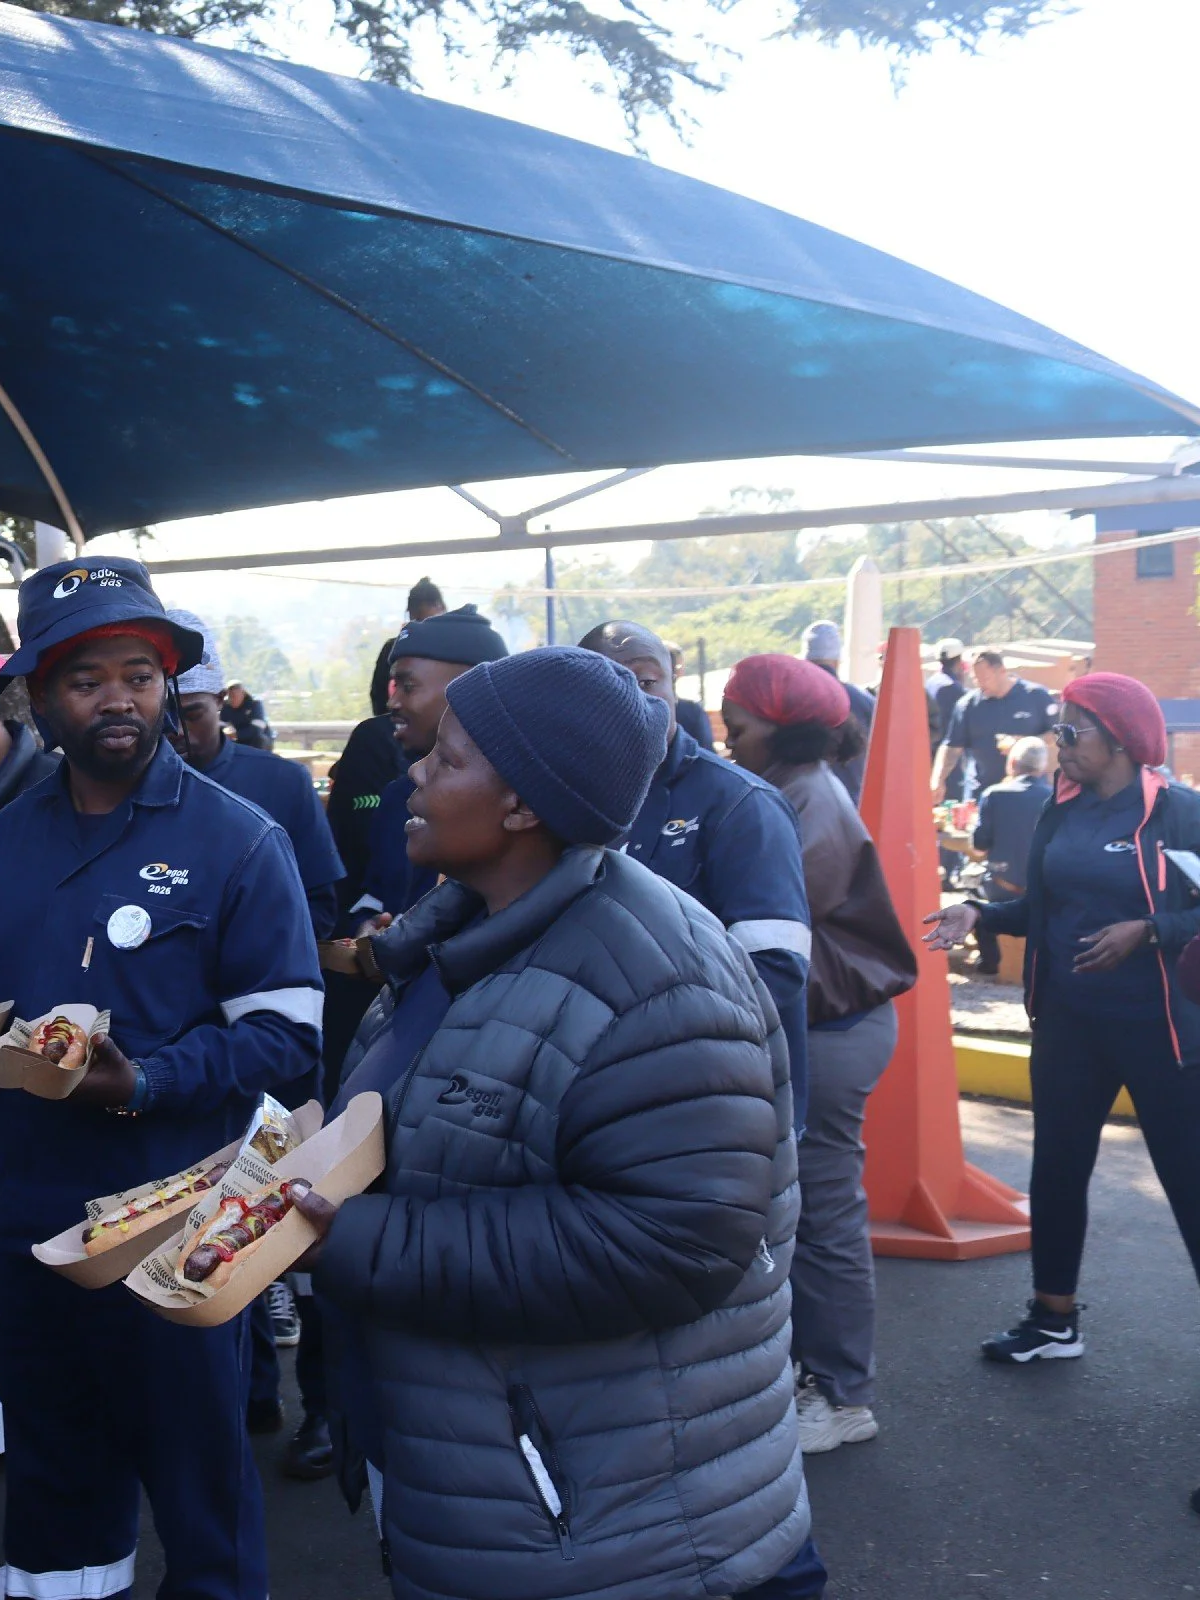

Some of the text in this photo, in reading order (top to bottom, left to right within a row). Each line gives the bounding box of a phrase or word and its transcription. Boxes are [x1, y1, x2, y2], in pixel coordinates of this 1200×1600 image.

[100, 577, 123, 587] gas
[166, 869, 189, 877] egoli
[172, 876, 189, 885] gas
[465, 1087, 502, 1106] egoli
[471, 1103, 501, 1119] gas
